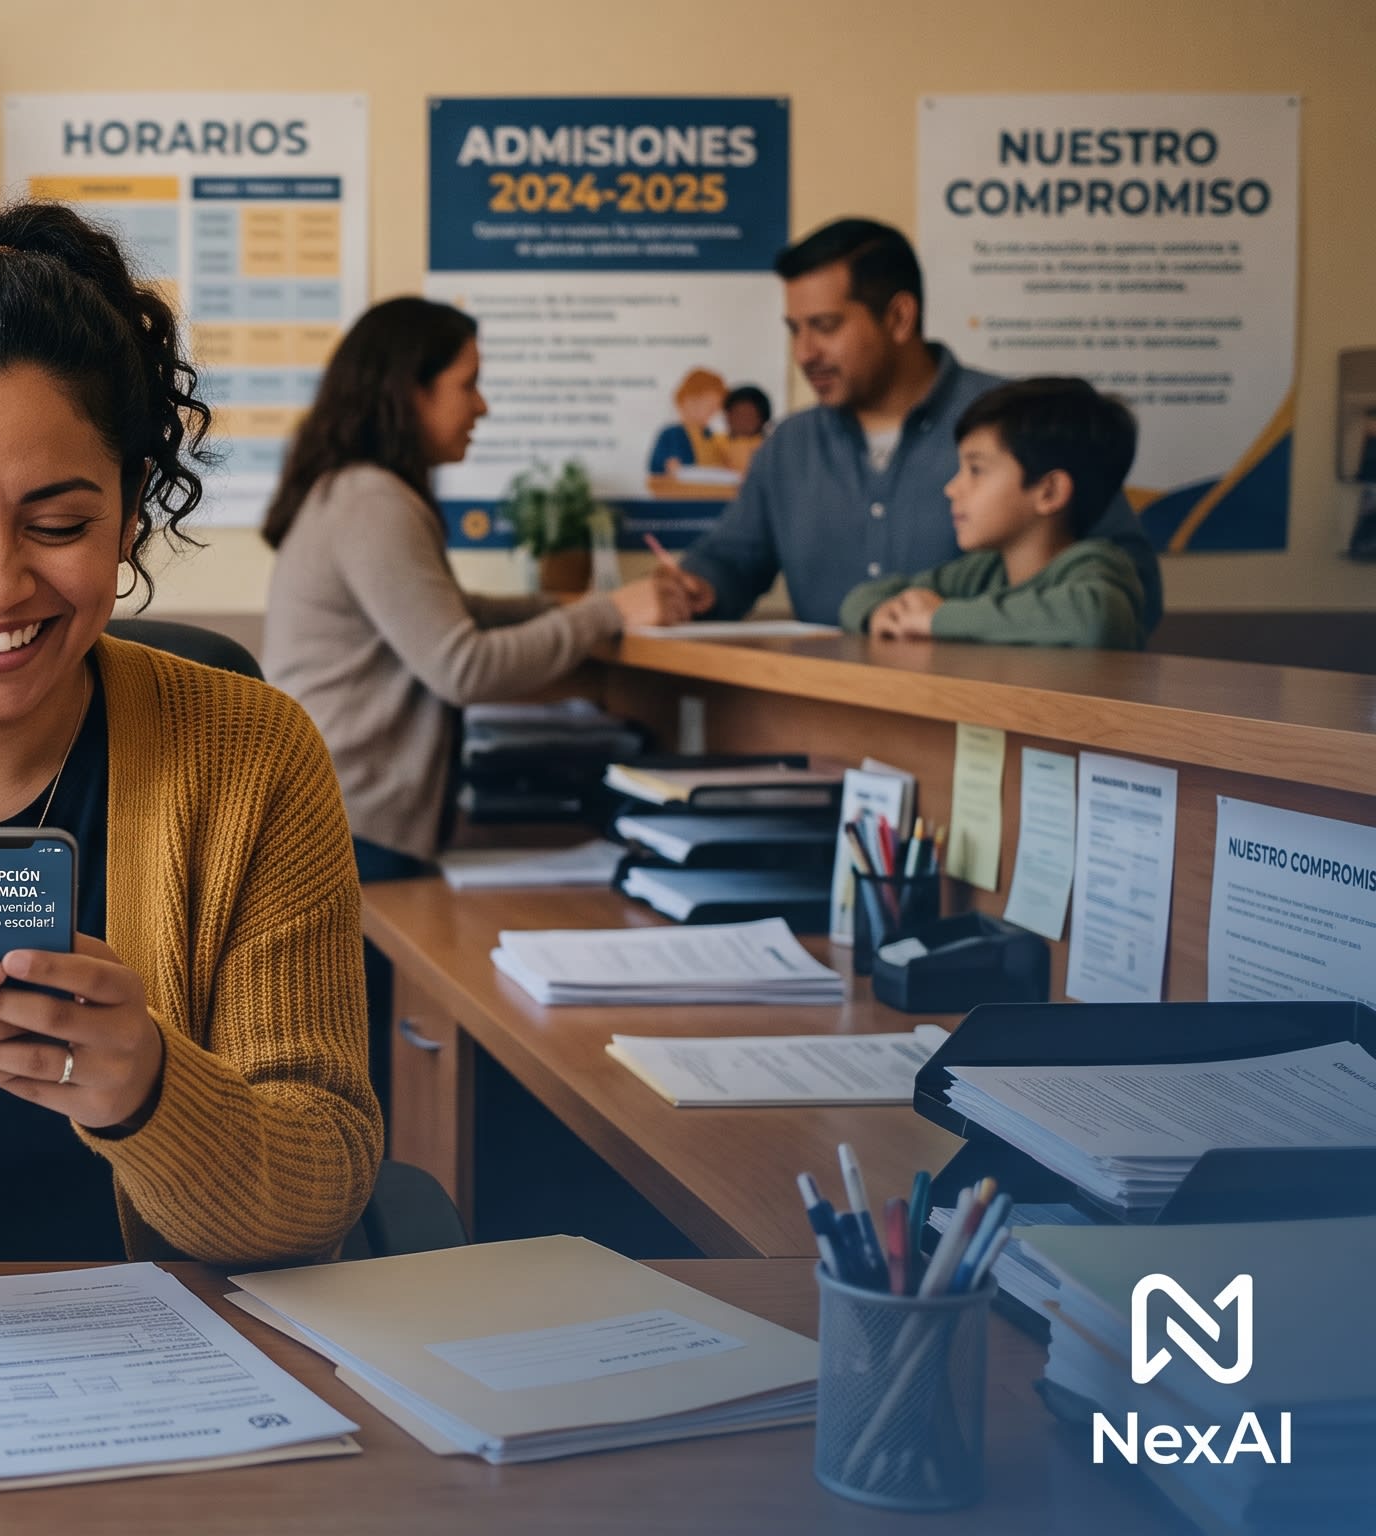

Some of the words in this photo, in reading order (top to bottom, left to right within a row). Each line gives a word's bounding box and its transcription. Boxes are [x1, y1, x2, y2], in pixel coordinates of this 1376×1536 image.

[62, 121, 309, 157] HORARIOS
[458, 125, 756, 166] ADMISIONES
[999, 129, 1219, 166] NUESTRO
[489, 174, 726, 212] 2024-2025
[946, 179, 1272, 216] COMPROMISO
[1228, 836, 1288, 869] NUESTRO
[44, 901, 55, 913] al
